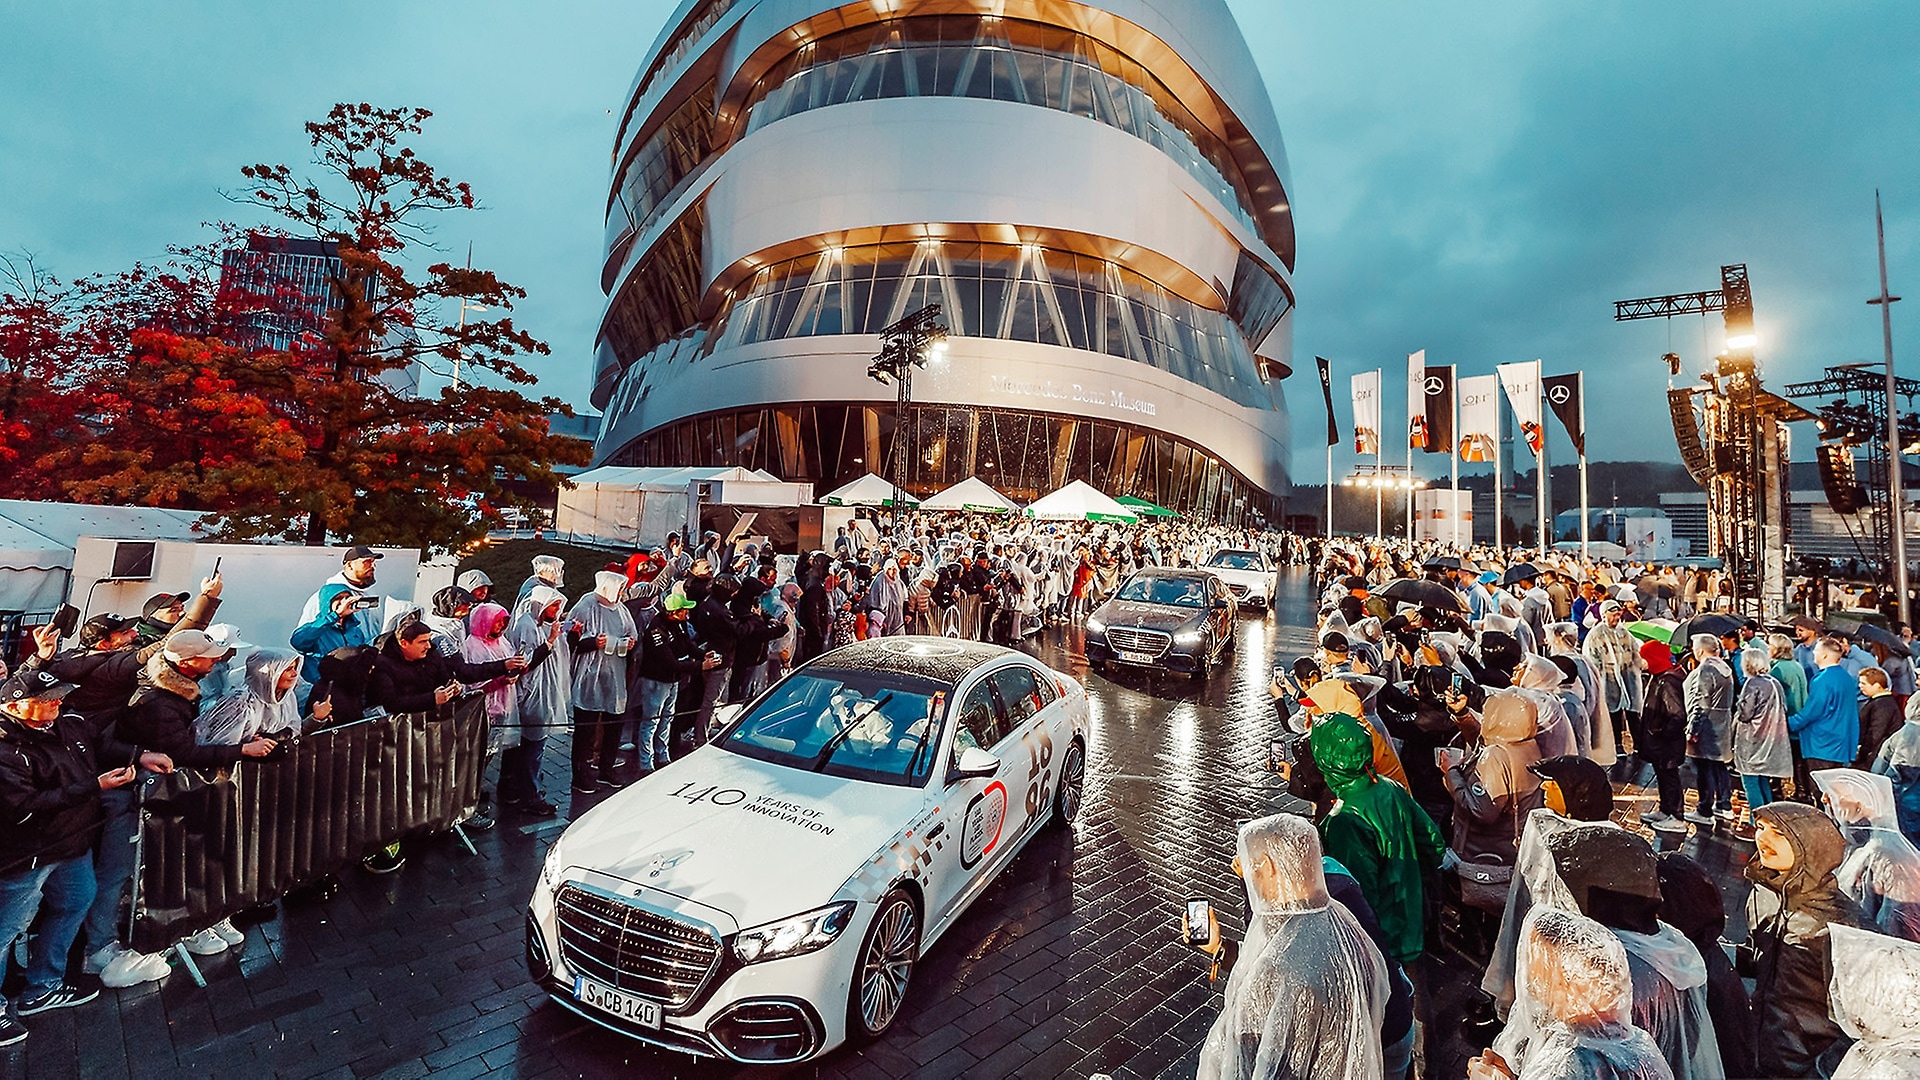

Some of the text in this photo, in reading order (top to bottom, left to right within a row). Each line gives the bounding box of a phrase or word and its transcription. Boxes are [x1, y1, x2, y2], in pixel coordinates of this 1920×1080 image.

[1110, 389, 1156, 416] Museum
[667, 782, 747, 805] 140
[742, 803, 835, 836] INNOVATION
[755, 795, 825, 819] YEARS OF
[624, 999, 655, 1024] 140
